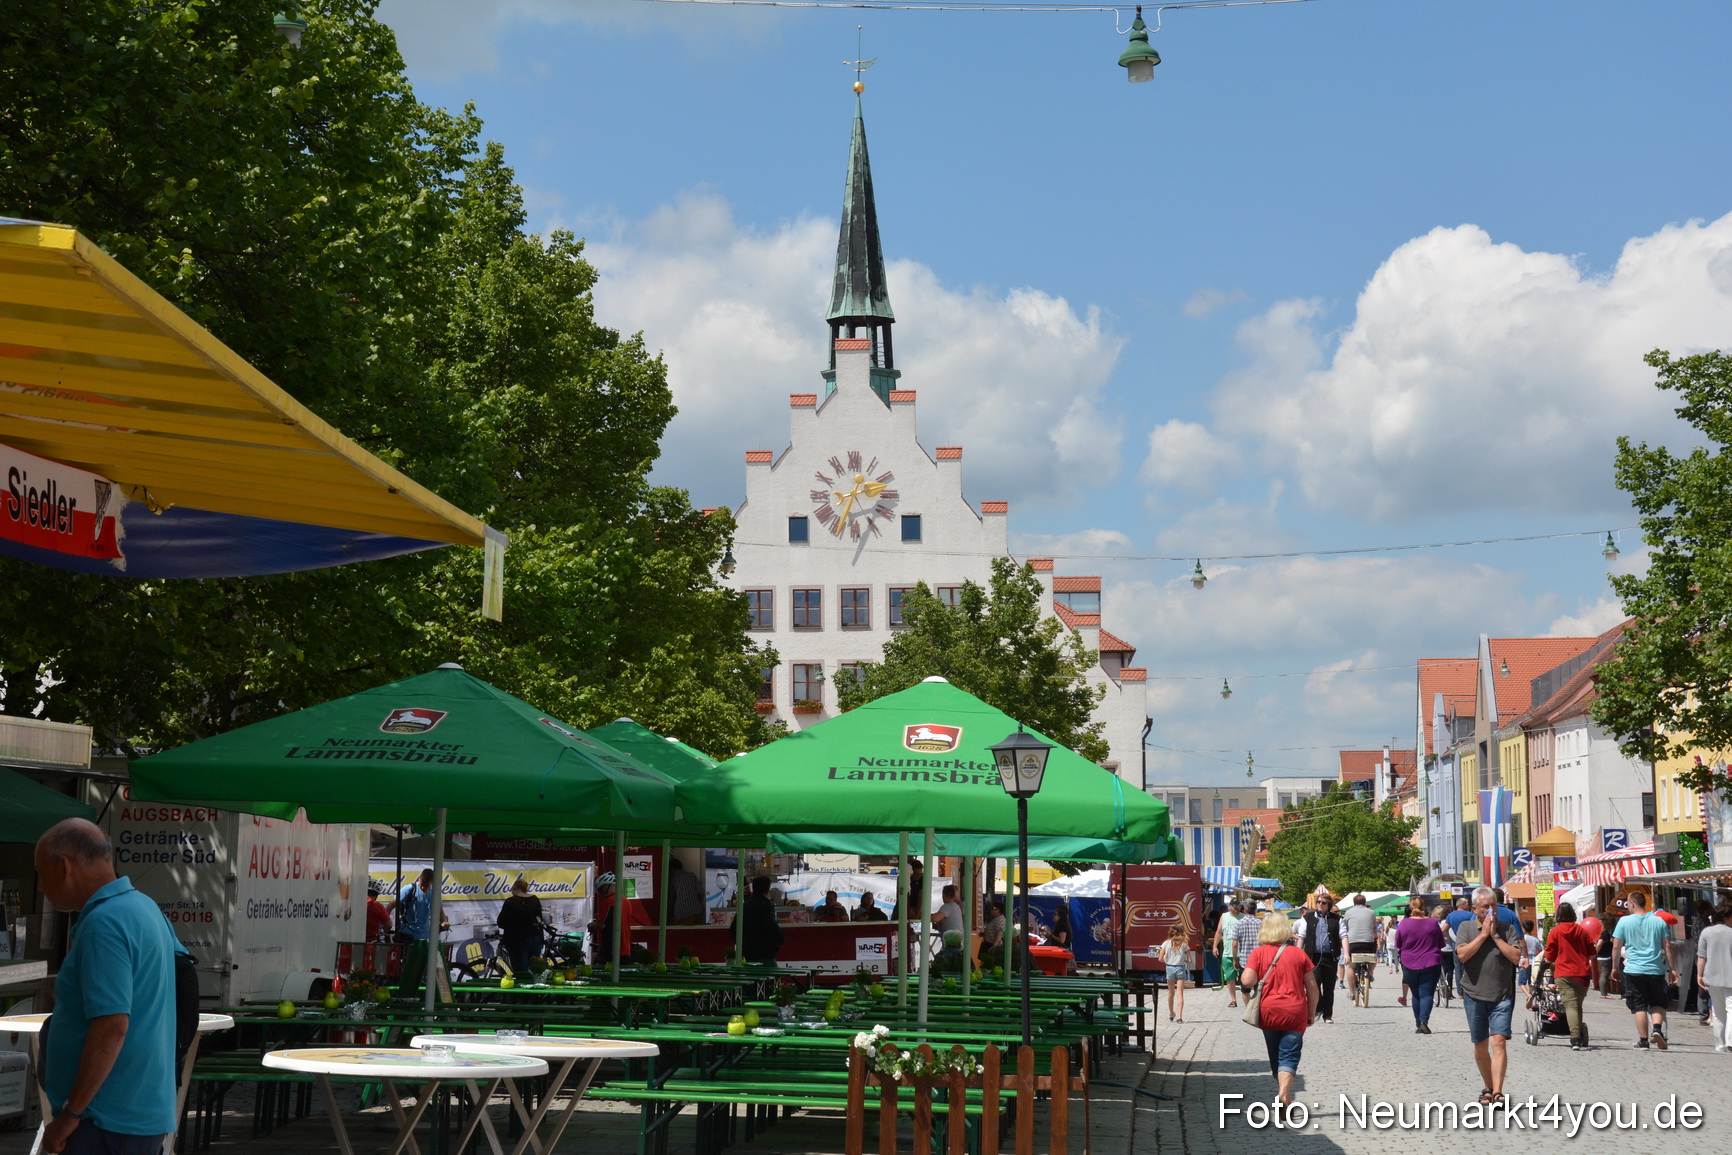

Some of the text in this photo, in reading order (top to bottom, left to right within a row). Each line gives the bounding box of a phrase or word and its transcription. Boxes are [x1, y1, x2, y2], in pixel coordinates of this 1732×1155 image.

[8, 466, 77, 536] Siedler
[322, 737, 464, 753] Neumarkter
[284, 747, 480, 766] Lammsbräu
[828, 766, 1001, 786] Lammsbrä
[120, 808, 218, 822] AUGSBACH
[119, 830, 206, 845] Getränke-
[118, 849, 216, 864] Center Süd
[249, 844, 331, 880] AUGSBACH
[484, 873, 582, 896] Wotraum!
[177, 901, 191, 909] Str.
[192, 901, 204, 909] 114
[246, 898, 329, 920] Getränke-Center Süd
